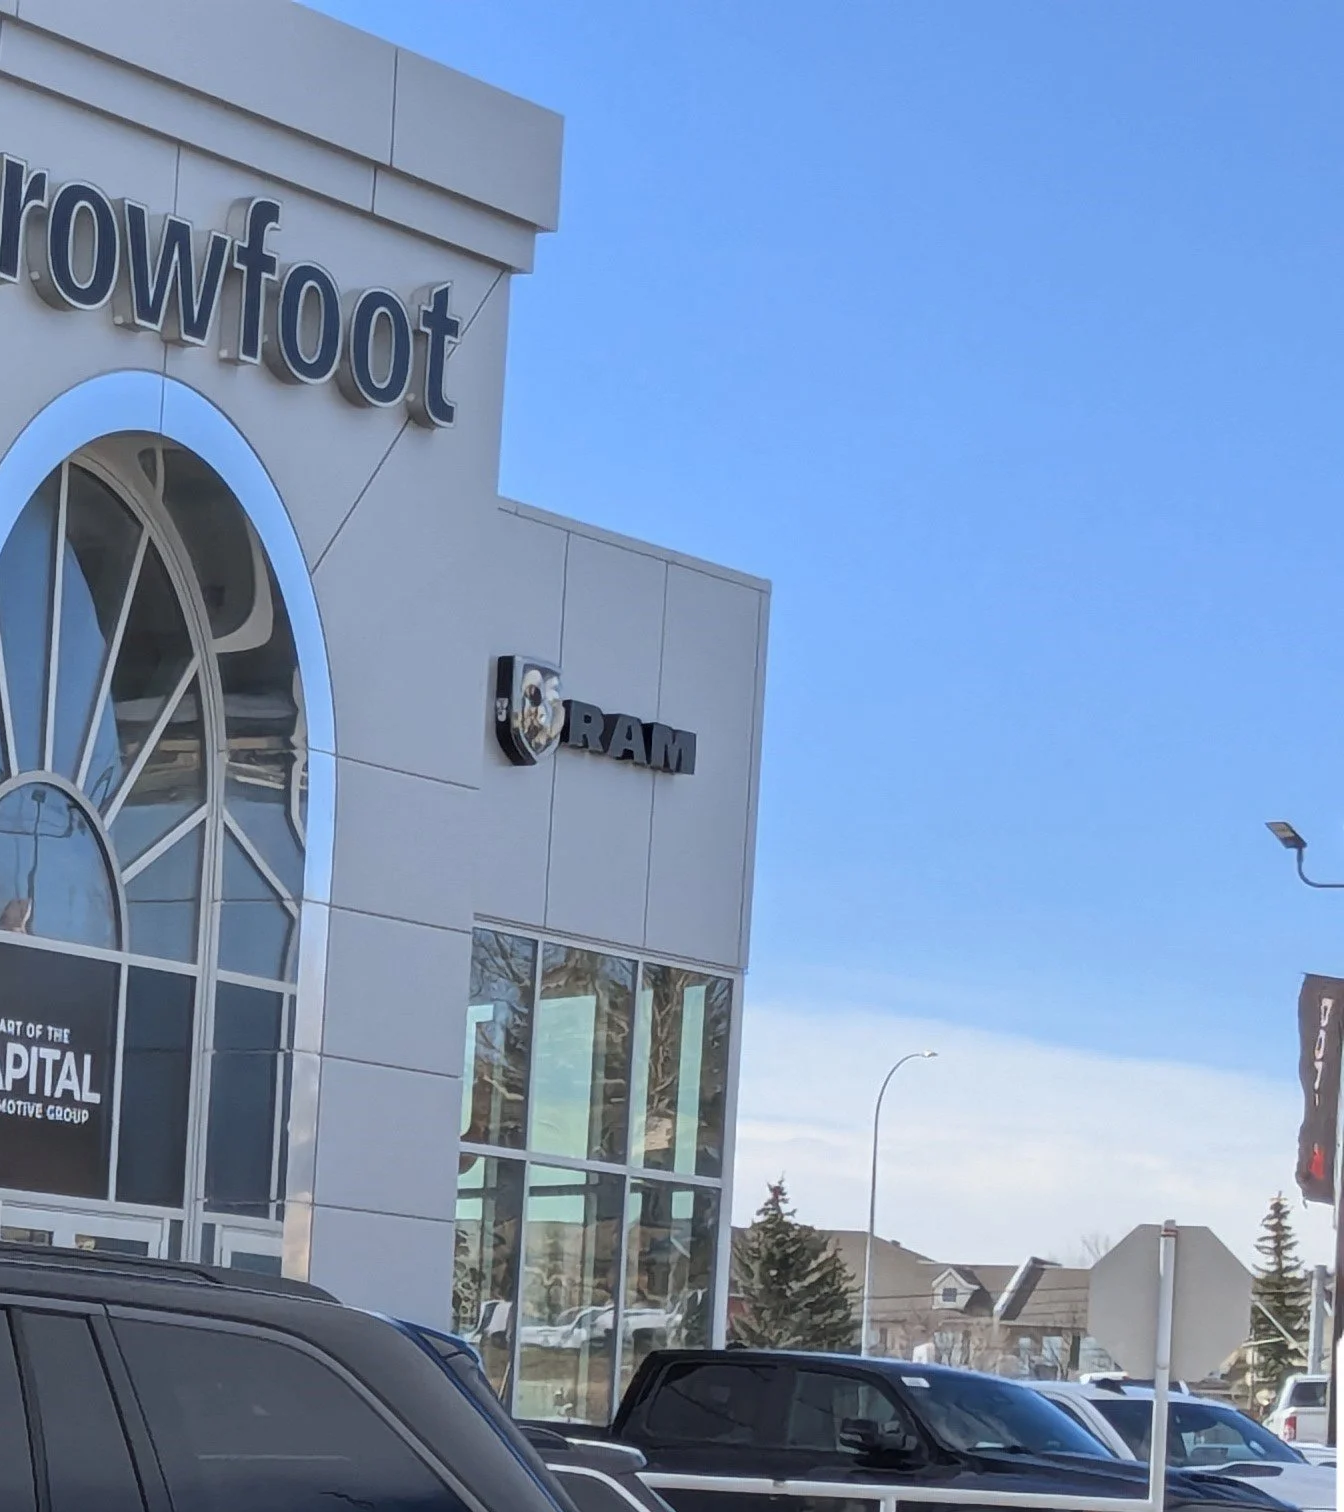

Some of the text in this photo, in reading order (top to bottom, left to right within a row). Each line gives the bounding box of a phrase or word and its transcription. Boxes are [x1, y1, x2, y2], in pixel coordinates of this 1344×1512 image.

[564, 699, 697, 775] RAM
[26, 1023, 43, 1040] OF
[47, 1026, 71, 1044] THE
[46, 1103, 89, 1125] GROUP
